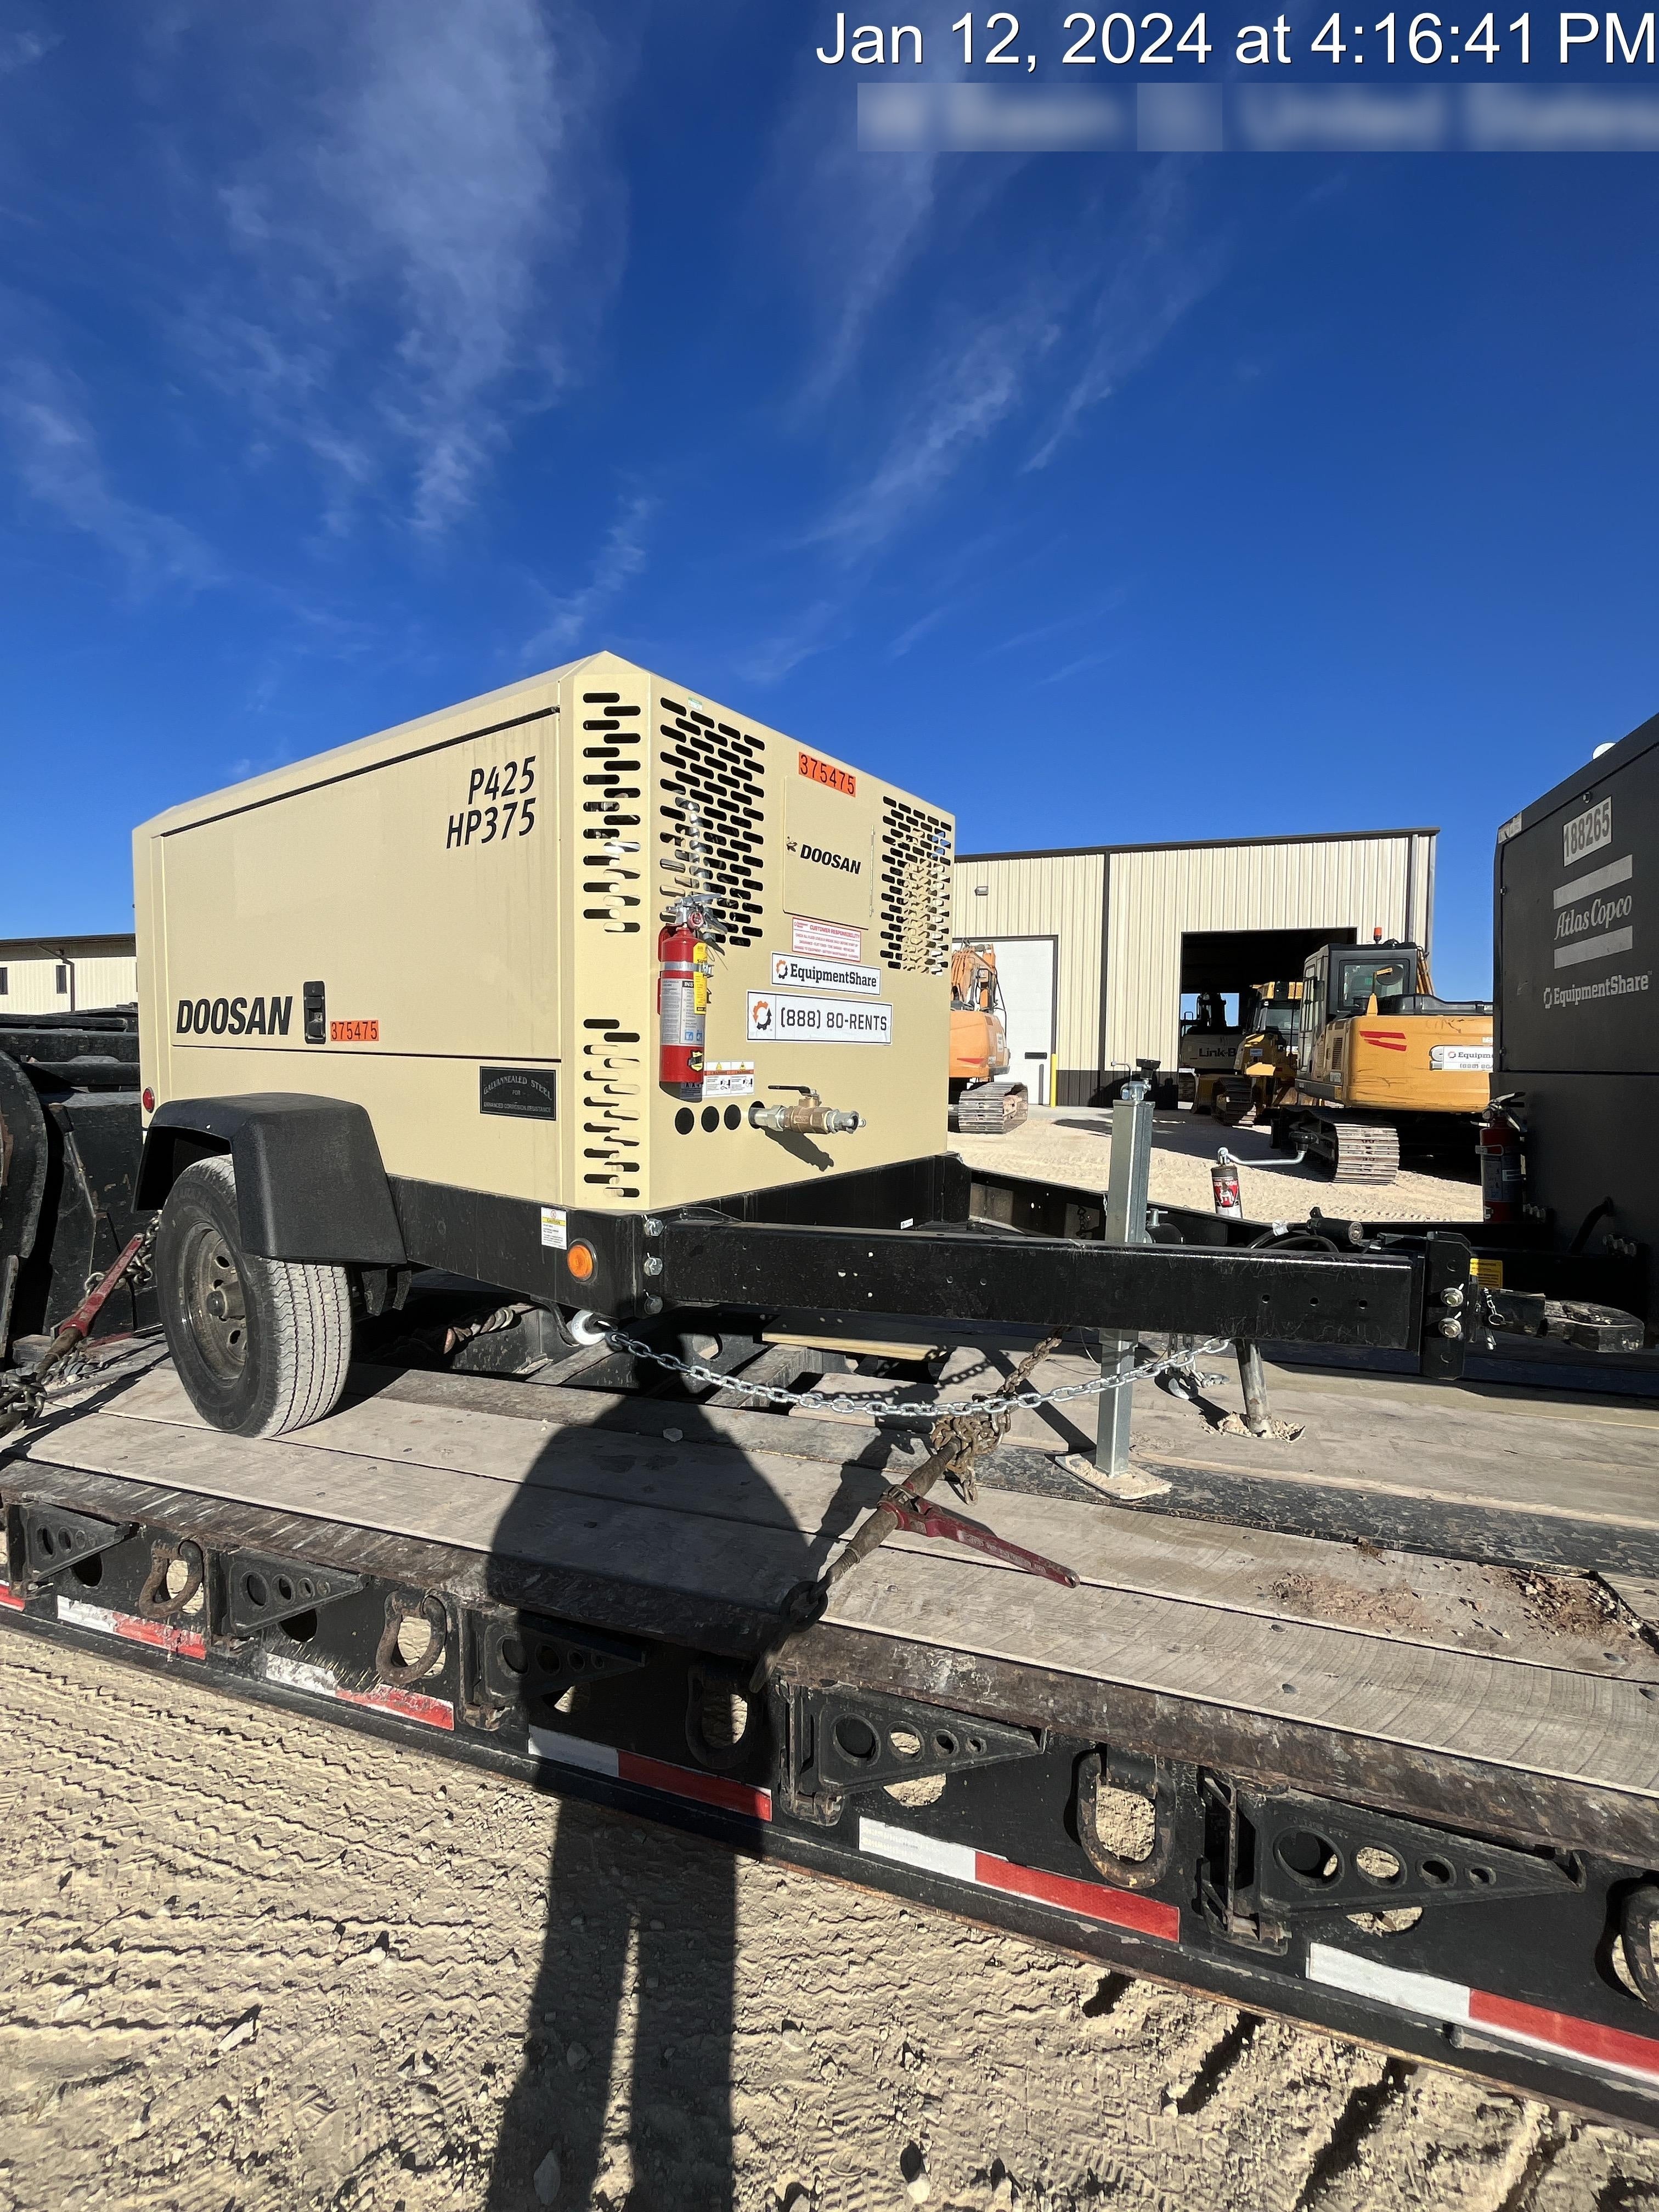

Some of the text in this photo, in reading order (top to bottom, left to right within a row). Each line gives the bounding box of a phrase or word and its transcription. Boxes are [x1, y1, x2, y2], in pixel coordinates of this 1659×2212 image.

[468, 755, 536, 805] P425
[800, 754, 855, 795] 375475
[447, 797, 536, 849] HP375
[1564, 801, 1610, 858] 188265
[800, 844, 861, 874] DOOSAN
[1554, 894, 1633, 941] Atlas Copco
[790, 963, 877, 987] EquipmentShare
[1554, 974, 1649, 1007] EquipmentShare
[176, 996, 293, 1035] DOOSAN
[331, 1021, 378, 1040] 375475
[781, 1007, 887, 1031] (888) 80-RENTS
[1199, 1047, 1237, 1057] Link-B
[483, 1075, 553, 1101] GALVANNEALED STEEL
